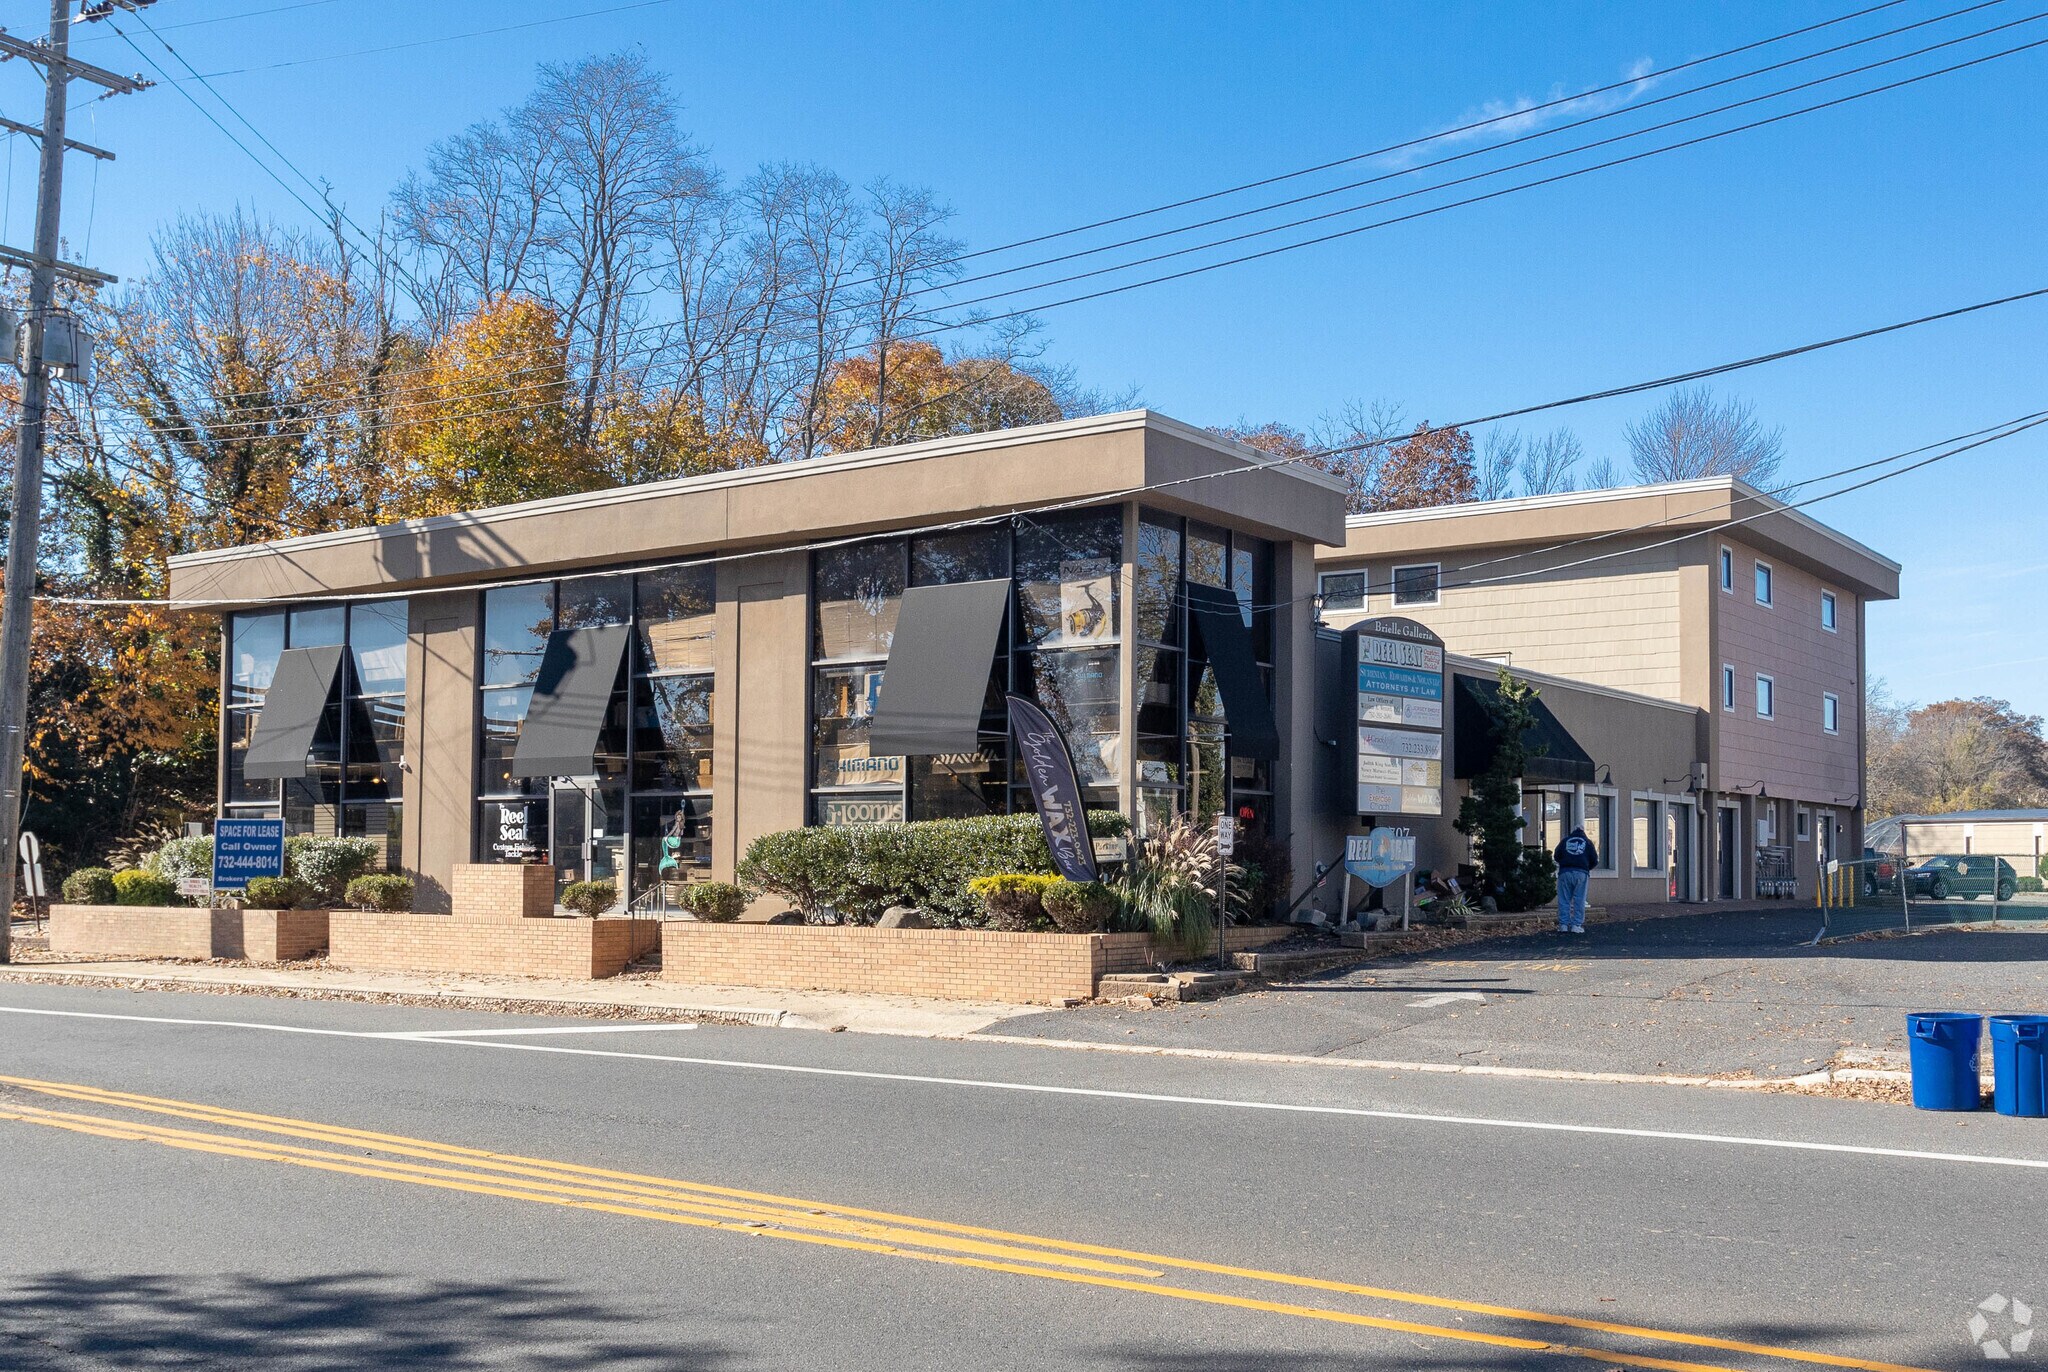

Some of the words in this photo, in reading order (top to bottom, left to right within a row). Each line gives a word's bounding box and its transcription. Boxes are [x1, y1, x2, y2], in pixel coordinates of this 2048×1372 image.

[1375, 621, 1401, 635] Brielle
[1402, 626, 1433, 640] Galleria
[1373, 640, 1398, 664] REEL
[1400, 642, 1422, 667] SEAT
[1366, 680, 1409, 693] ATTORNEYS
[1421, 686, 1437, 696] LAW
[1023, 732, 1054, 786] Golden
[1042, 784, 1072, 847] WAX
[500, 805, 528, 824] Reel
[1240, 806, 1254, 819] OPEN
[220, 825, 241, 837] SPACE
[243, 825, 257, 837] FOR
[257, 825, 279, 838] LEASE
[500, 824, 528, 840] Seat
[1221, 821, 1232, 829] ONE
[221, 842, 240, 850] Call
[243, 842, 277, 850] Owner
[505, 850, 523, 858] Tackle
[1348, 839, 1373, 862] REEL
[218, 855, 279, 869] 732-444-8014
